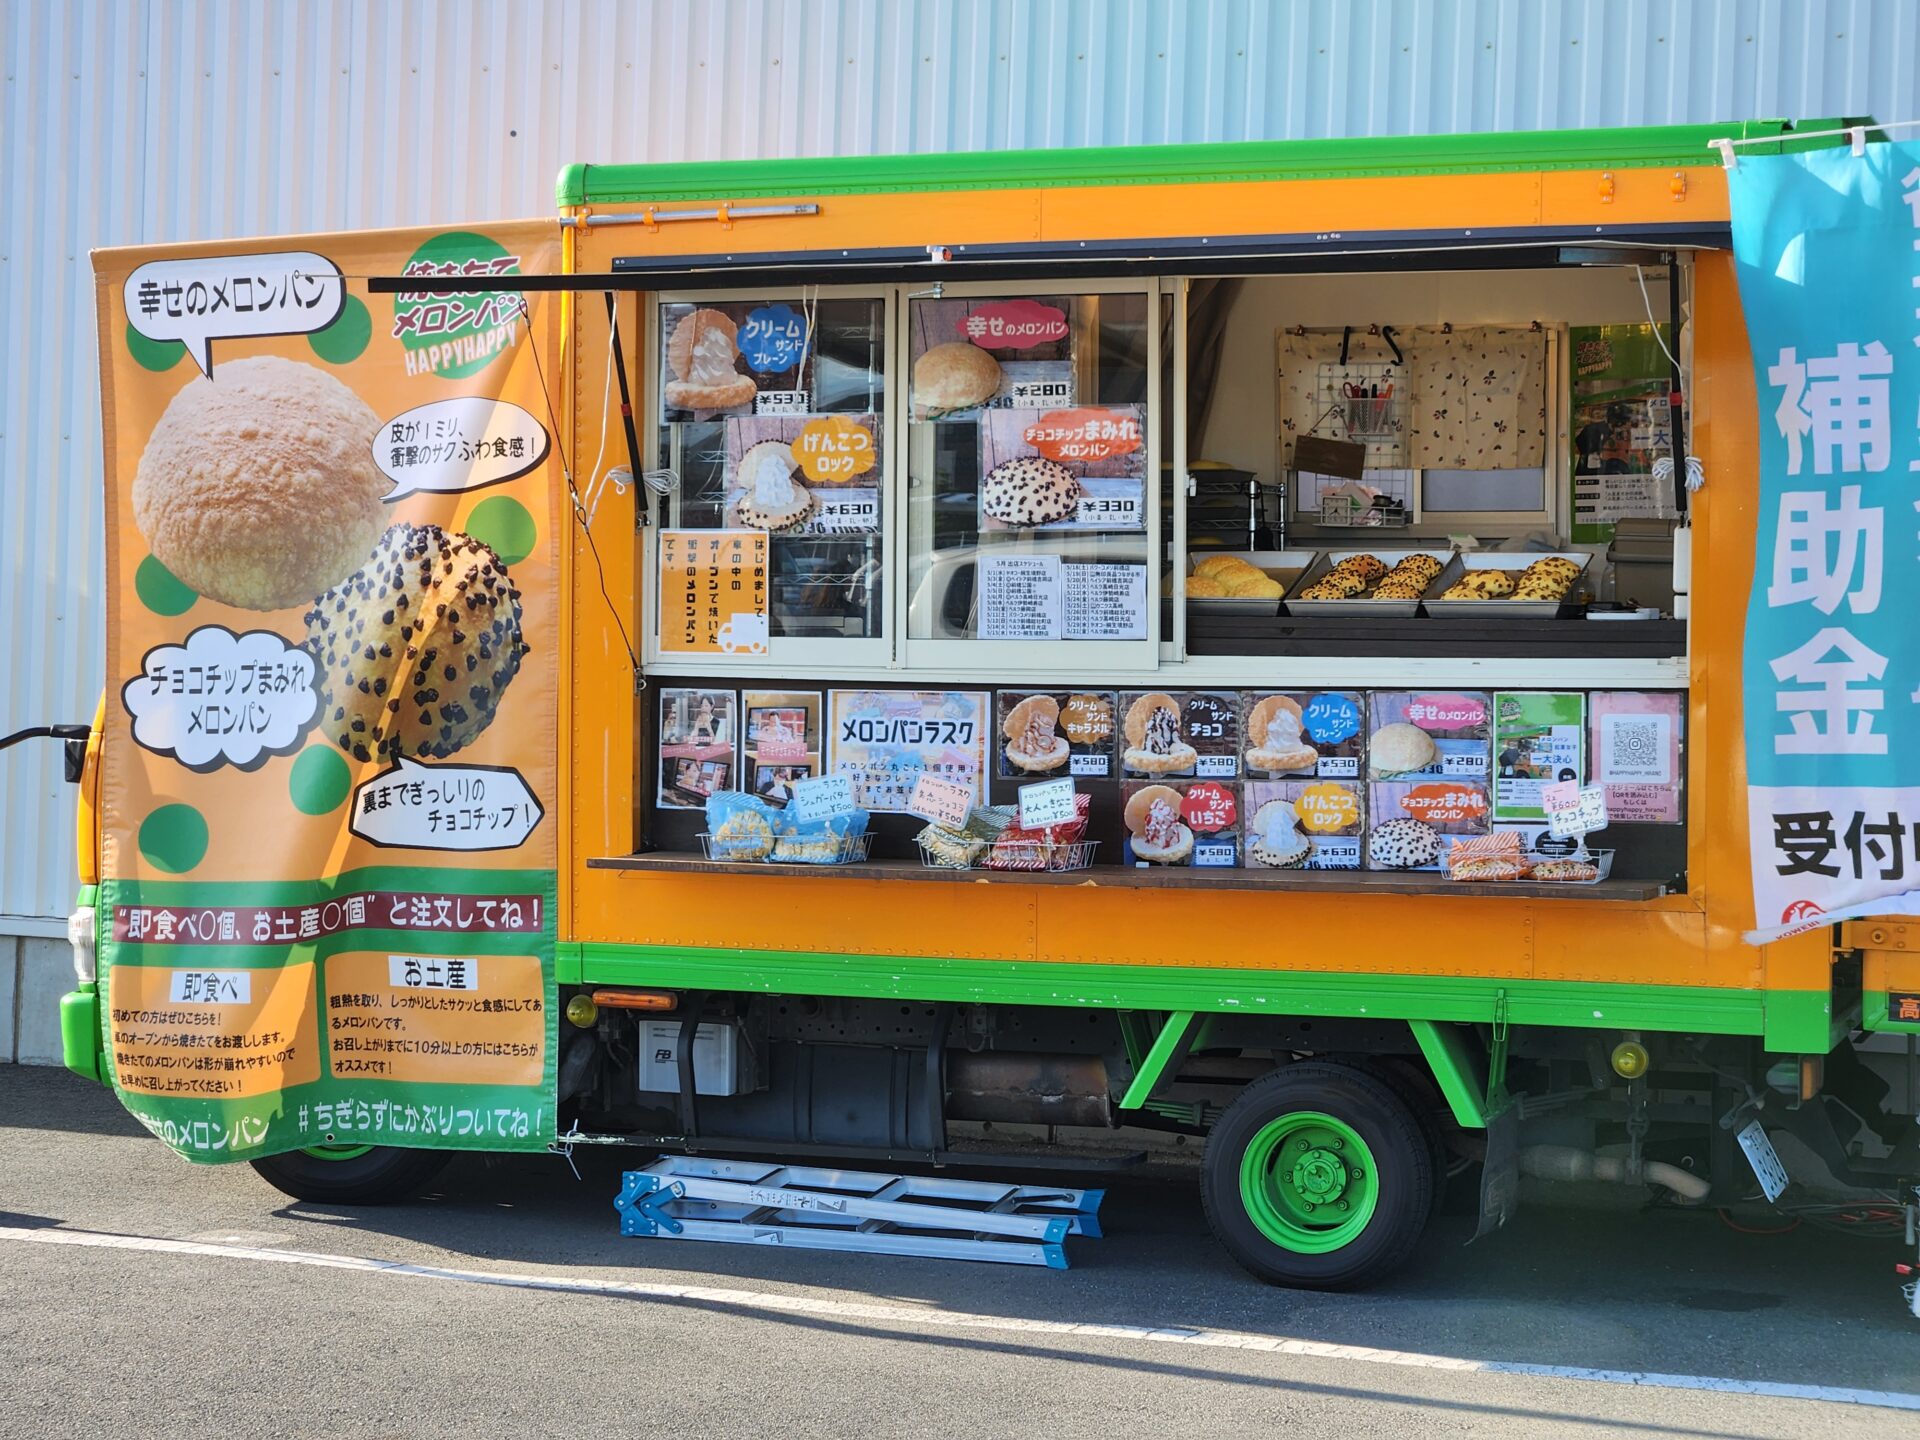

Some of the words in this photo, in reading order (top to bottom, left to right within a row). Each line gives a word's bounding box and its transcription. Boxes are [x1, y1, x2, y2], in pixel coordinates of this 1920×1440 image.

[138, 270, 326, 320] 幸せのメロンパン
[391, 295, 527, 338] メロンパン
[746, 320, 800, 338] クリーム
[966, 315, 1066, 338] 幸せのメロンパン
[404, 321, 518, 377] HAPPYHAPPY
[775, 339, 804, 352] サンド
[1014, 384, 1067, 397] ¥280
[1026, 419, 1138, 442] チョコチップまみれ
[803, 432, 868, 452] げんこつ
[1058, 444, 1110, 457] メロンパン
[816, 456, 855, 473] ロック
[825, 503, 873, 515] ¥630
[1083, 500, 1135, 512] ¥330
[1768, 339, 1893, 755] 補助金
[731, 540, 741, 590] 車の中の
[685, 539, 697, 644] 衝撃のメロンパン
[708, 540, 720, 644] オーブンで焼いた
[150, 660, 307, 697] チョコチップまみれ
[1069, 701, 1097, 711] クリーム
[1190, 701, 1218, 711] クリーム
[1308, 704, 1350, 718] クリーム
[1409, 703, 1484, 720] 幸せのメロンパン
[186, 705, 272, 735] メロンパン
[1086, 712, 1109, 721] サンド
[1211, 711, 1234, 721] サンド
[842, 718, 974, 745] メロンパンラスク
[1068, 723, 1110, 735] キャラメル
[1190, 723, 1223, 737] チョコ
[1072, 757, 1106, 766] ¥580
[1199, 757, 1234, 767] ¥580
[1320, 759, 1356, 768] ¥530
[1444, 756, 1484, 767] ¥280
[1532, 755, 1573, 765] 一大決心
[362, 778, 485, 814] 裏までぎっしりの
[1189, 788, 1220, 799] クリーム
[1402, 793, 1484, 808] チョコチップまみれ
[1209, 799, 1233, 810] サンド
[1303, 796, 1353, 810] げんこつ
[1190, 810, 1227, 826] いちご
[1313, 813, 1342, 826] ロック
[1425, 810, 1465, 819] メロンパン
[1199, 848, 1232, 857] ¥580
[1320, 847, 1357, 857] ¥630
[1772, 811, 1920, 881] 受付
[403, 959, 466, 989] お土産
[181, 972, 239, 1003] 即食べ
[331, 1016, 408, 1031] るメロンパンです。
